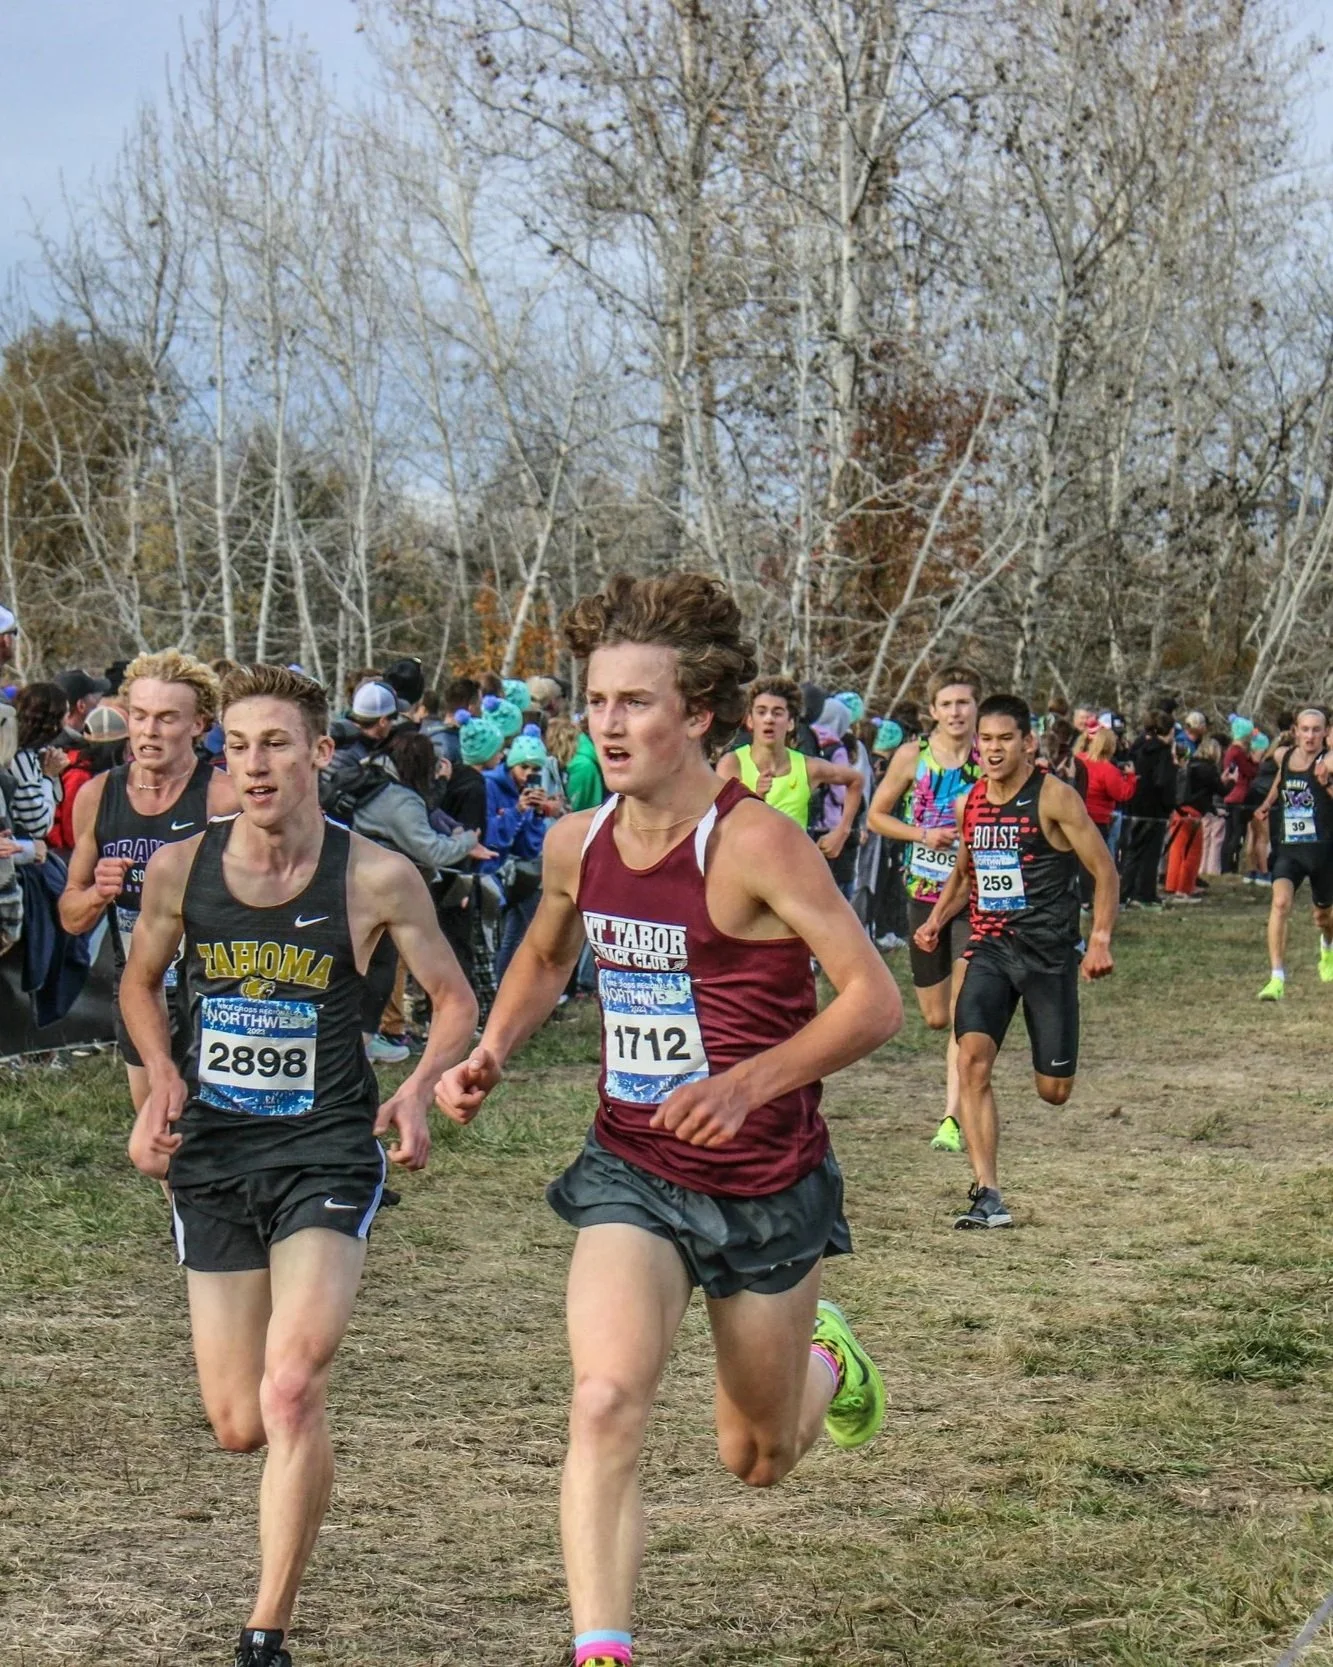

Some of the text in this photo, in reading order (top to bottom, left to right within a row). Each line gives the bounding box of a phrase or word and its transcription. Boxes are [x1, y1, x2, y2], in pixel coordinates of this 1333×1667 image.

[973, 825, 1019, 849] BOISE
[1291, 821, 1306, 832] 39
[916, 847, 957, 868] 2309
[982, 875, 1013, 891] 259
[610, 920, 687, 955] TABOR
[196, 941, 334, 990] TAHOMA
[632, 952, 670, 971] CLUB
[614, 1025, 692, 1062] 1712
[207, 1041, 308, 1079] 2898
